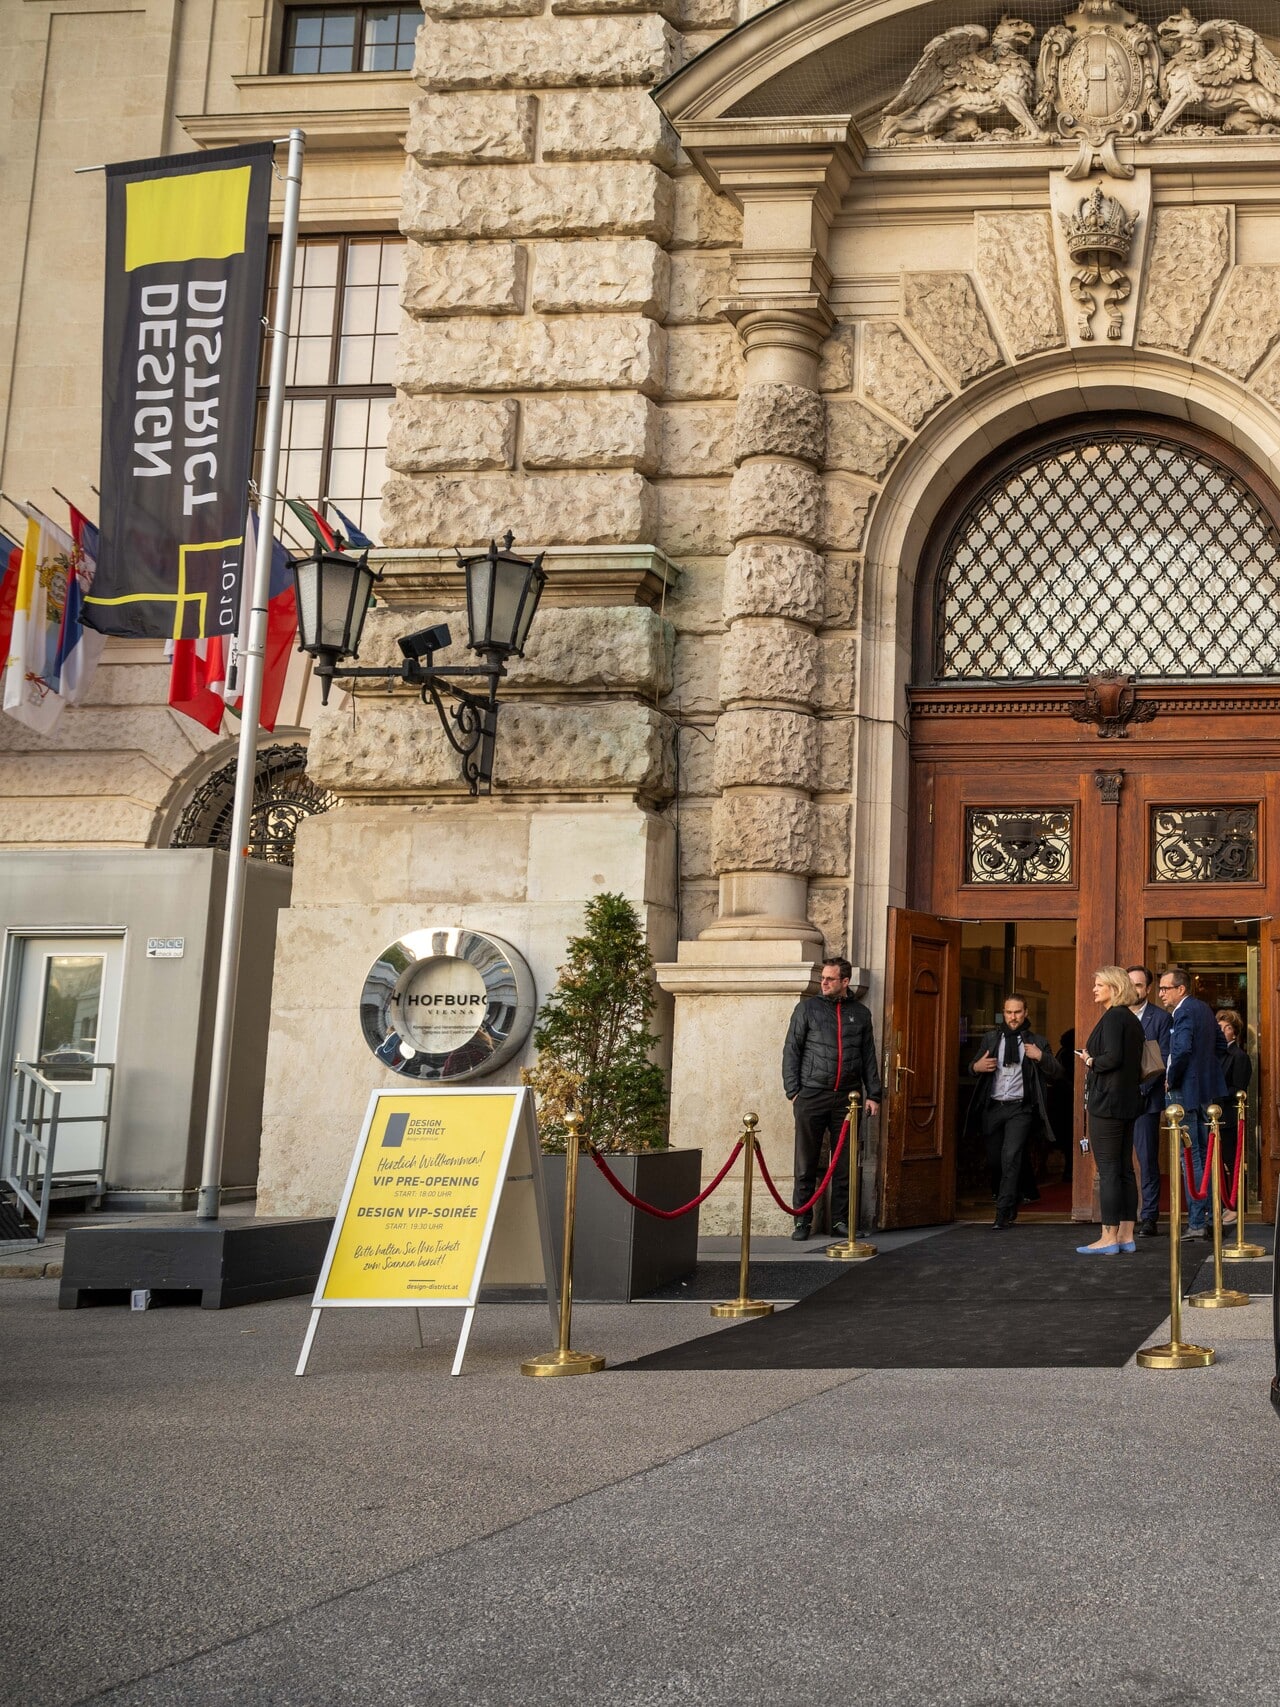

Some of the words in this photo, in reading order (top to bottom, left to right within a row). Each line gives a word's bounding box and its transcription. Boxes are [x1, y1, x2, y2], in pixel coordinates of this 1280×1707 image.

[410, 1119, 442, 1127] DESIGN
[407, 1127, 446, 1136] DISTRICT
[377, 1154, 417, 1172] Herzlich
[419, 1150, 486, 1169] Willkommen!
[373, 1176, 394, 1187] VIP
[396, 1176, 480, 1187] PRE-OPENING
[357, 1207, 404, 1218] DESIGN
[408, 1205, 479, 1218] VIP-SOIRÉE
[434, 1240, 461, 1254] Tickets
